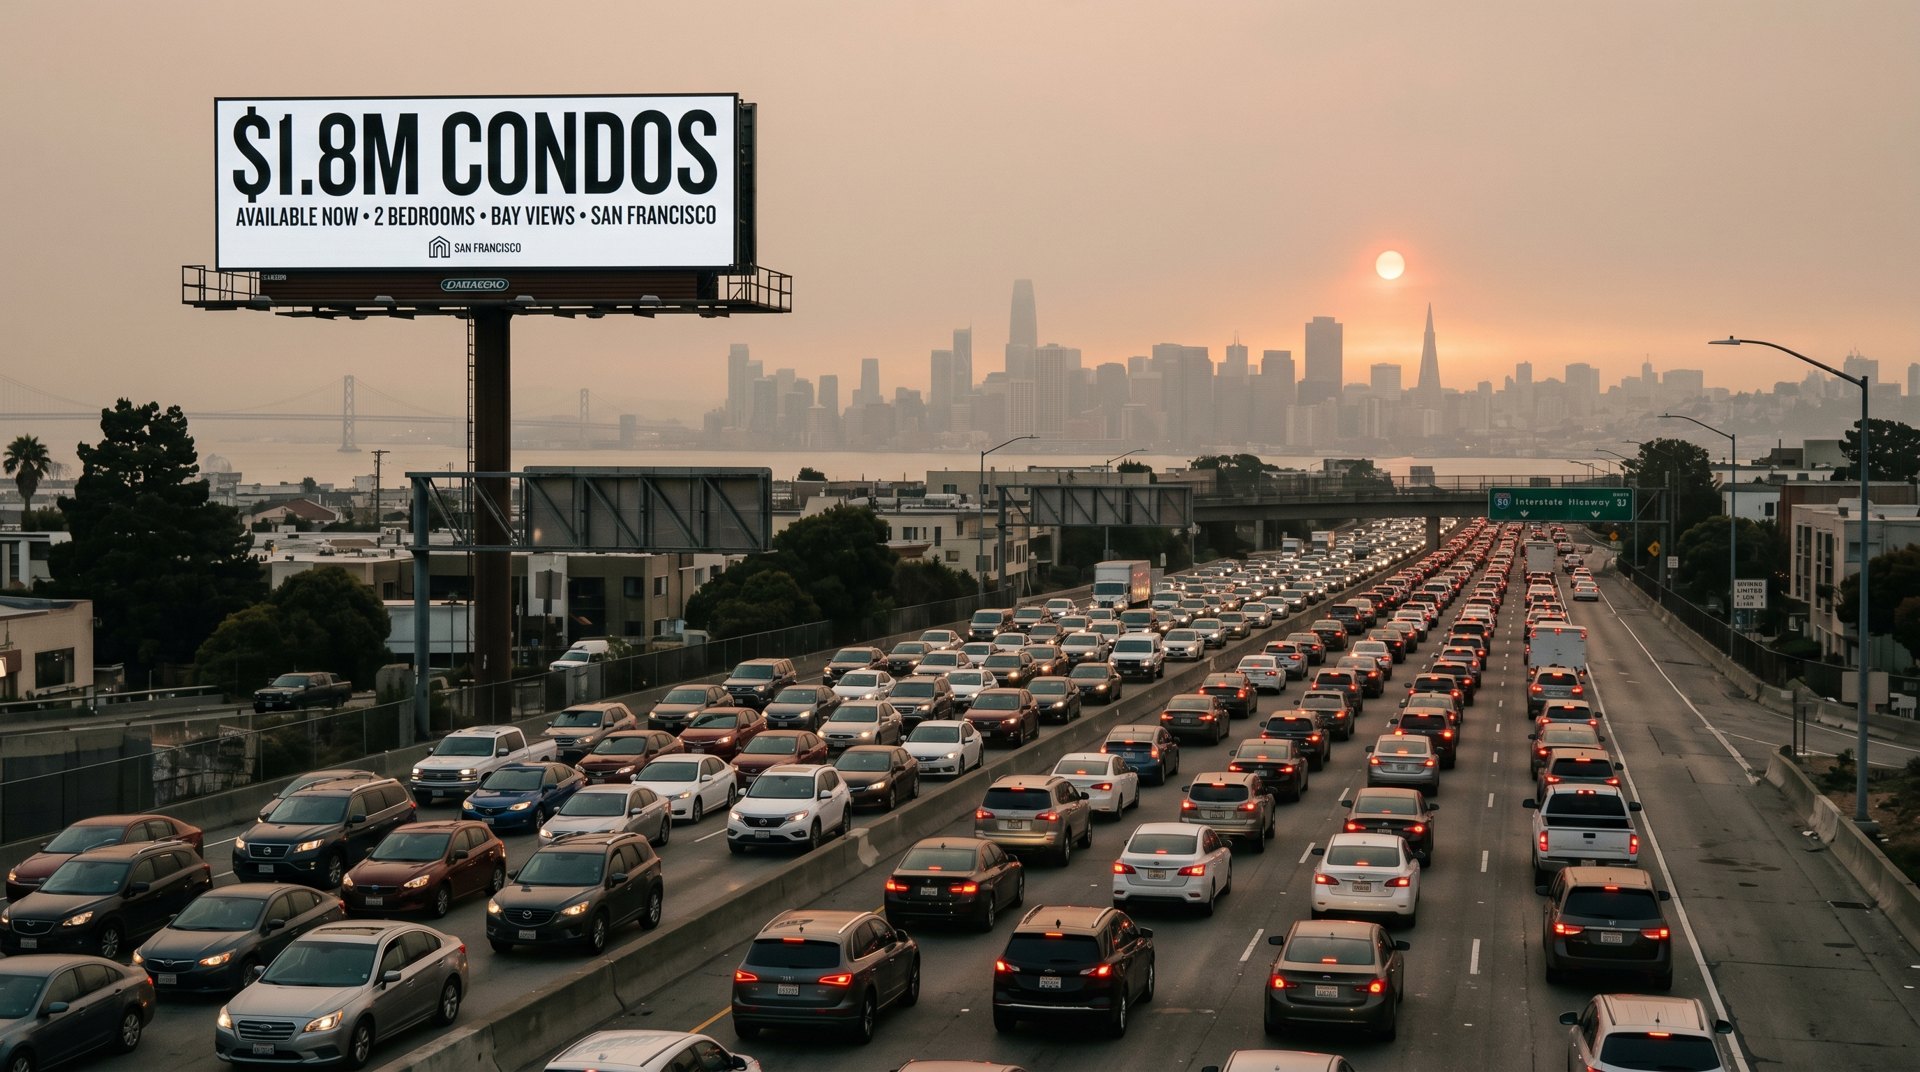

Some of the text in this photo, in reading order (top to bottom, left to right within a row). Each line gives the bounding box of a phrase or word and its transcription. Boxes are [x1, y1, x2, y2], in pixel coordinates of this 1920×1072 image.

[233, 106, 717, 203] $1.8M CONDOS
[236, 205, 716, 226] AVAILABLE NOW 2 BEDROOMS BAY VIEWS SAN FRANCISCO
[455, 243, 521, 252] SAN FRANCISCO
[1515, 498, 1563, 506] Interstate
